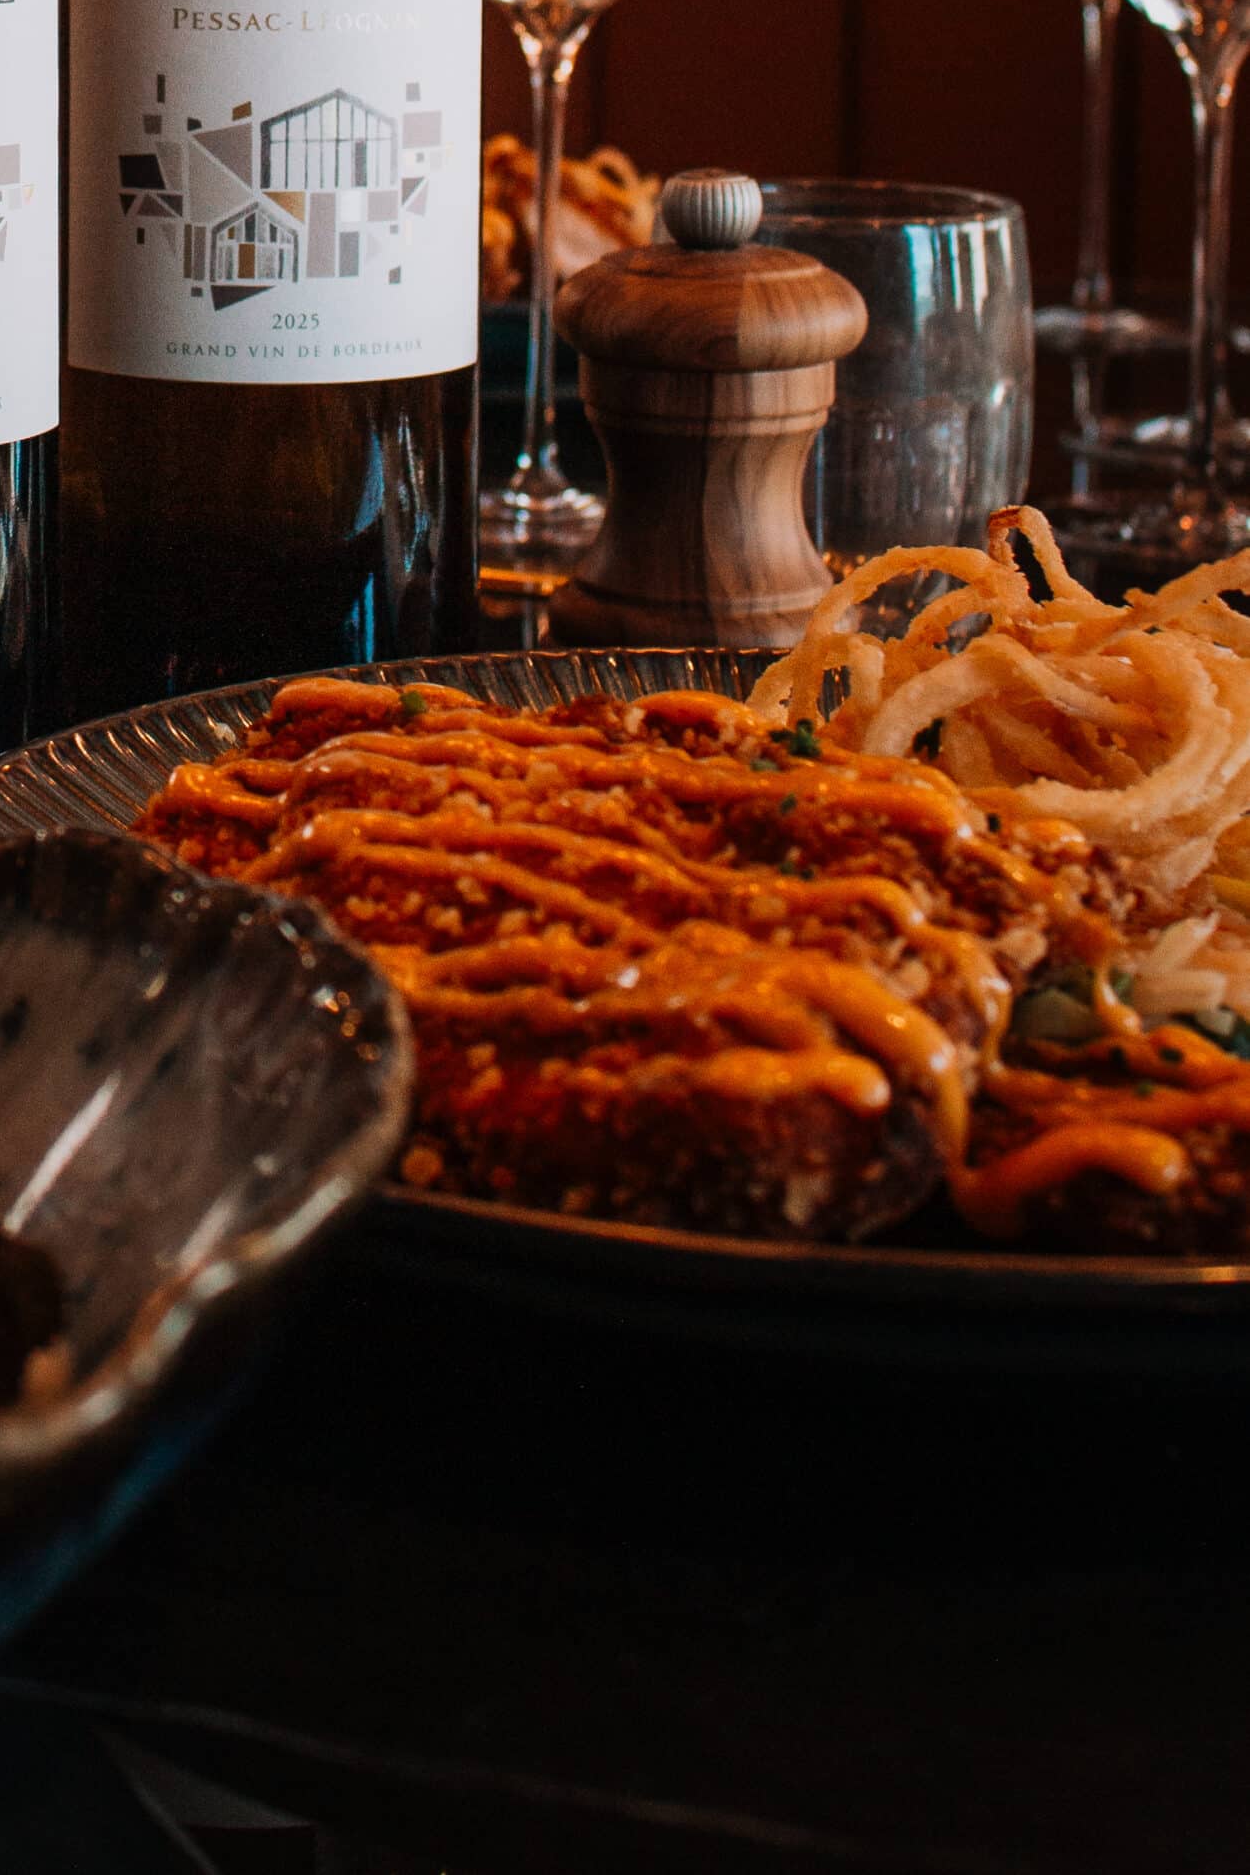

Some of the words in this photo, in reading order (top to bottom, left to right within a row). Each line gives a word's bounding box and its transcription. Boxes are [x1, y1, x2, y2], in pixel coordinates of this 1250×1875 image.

[271, 312, 321, 331] 2025
[166, 340, 237, 358] GRAND
[248, 344, 286, 358] VIN
[298, 344, 322, 358] DE
